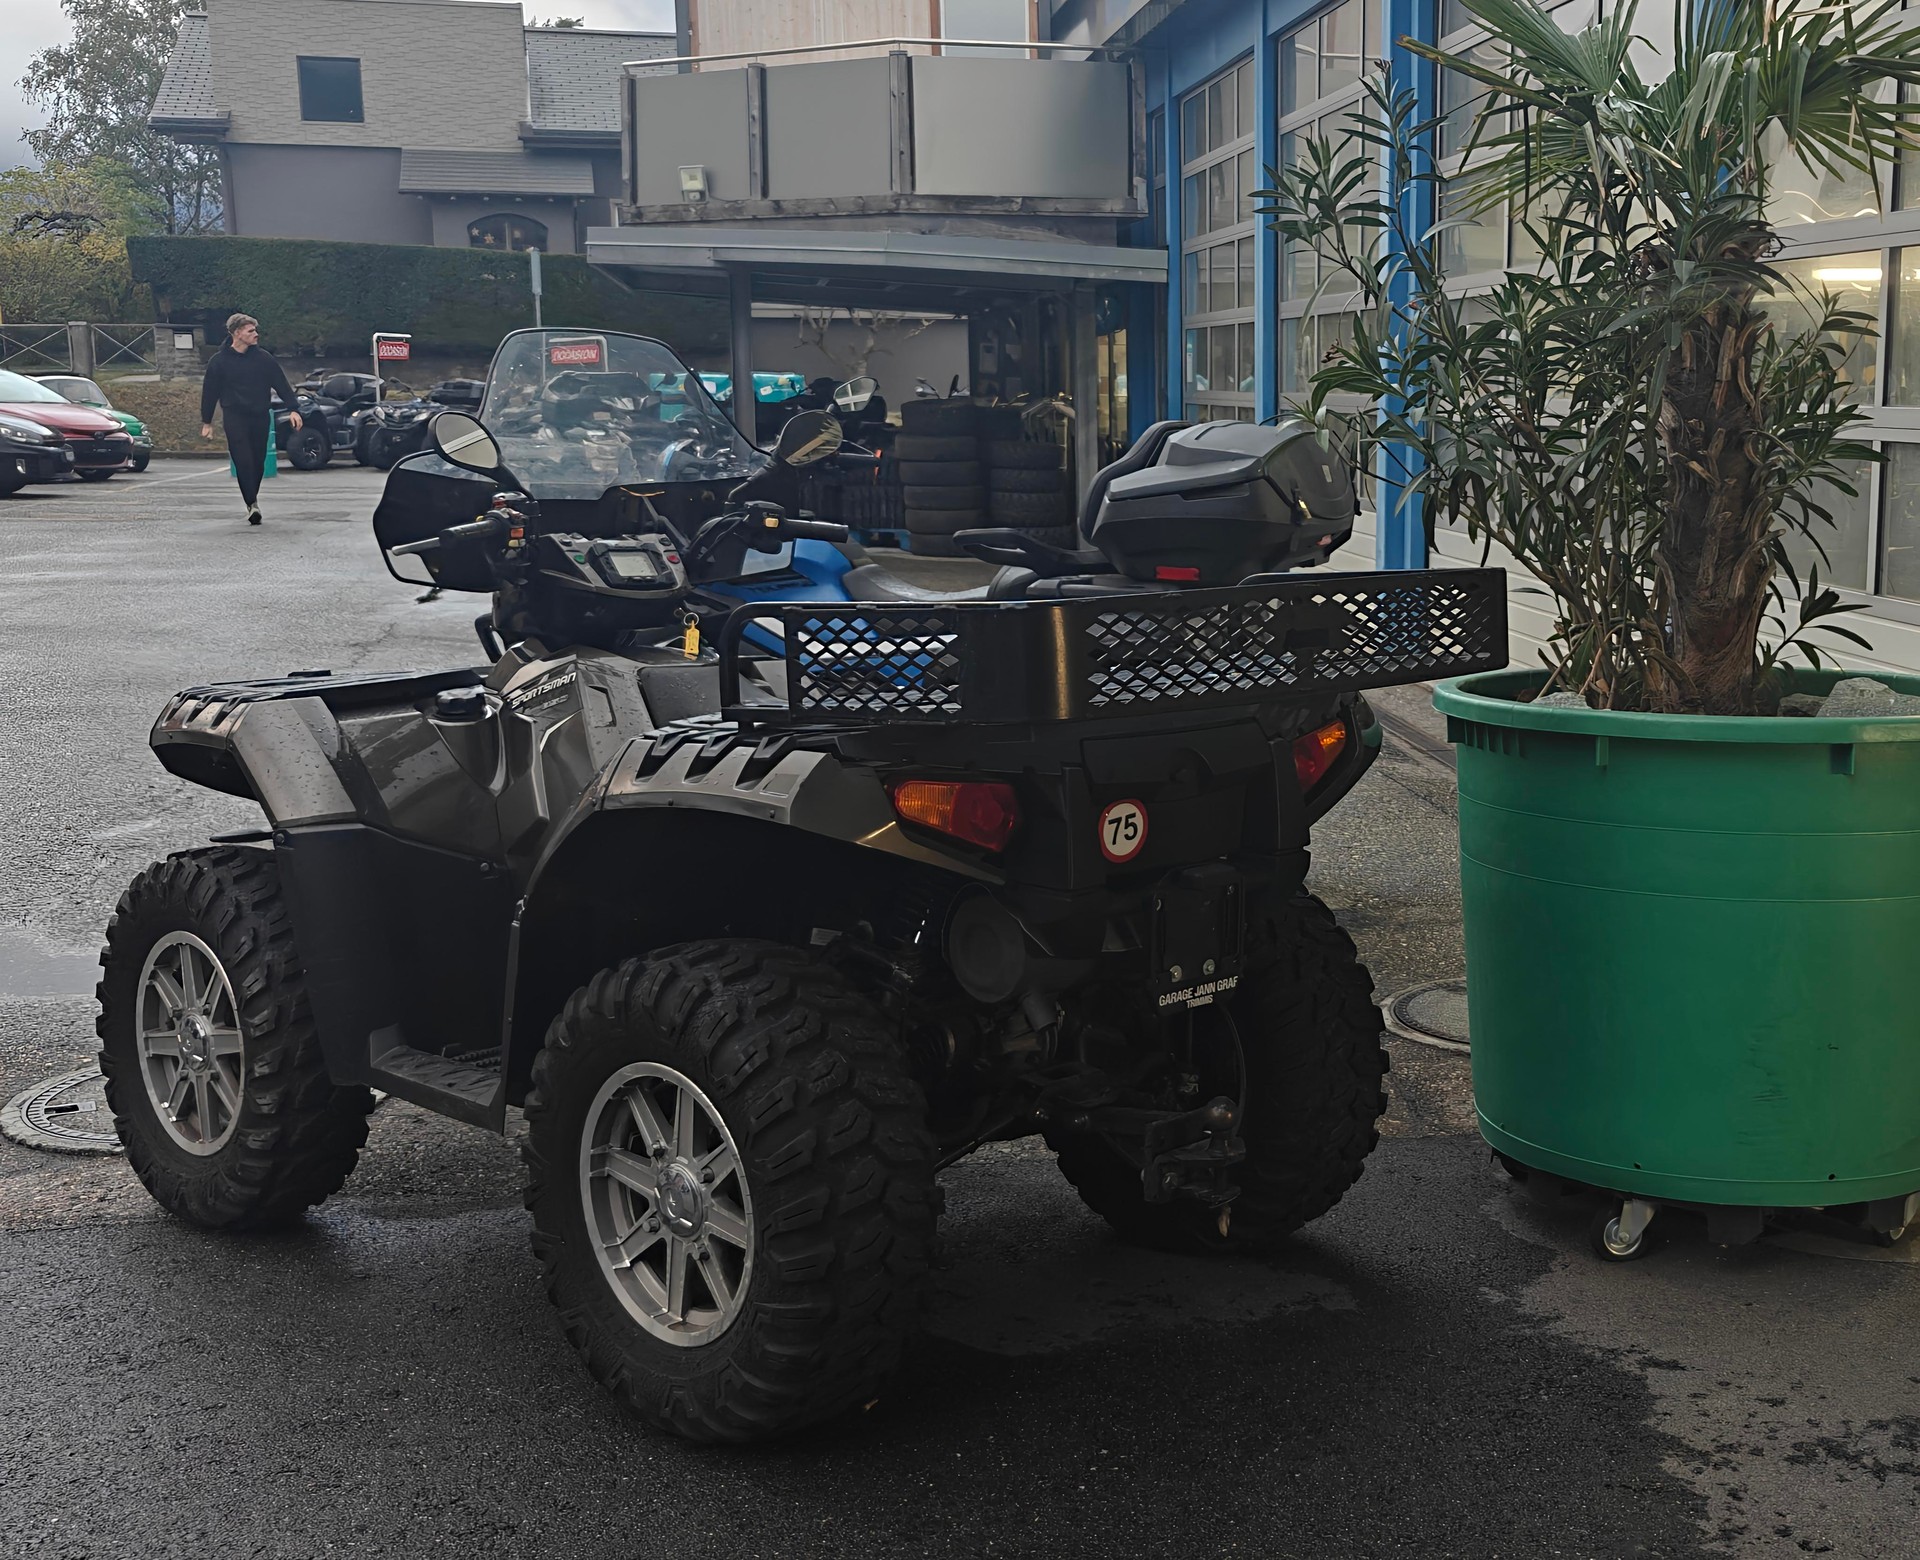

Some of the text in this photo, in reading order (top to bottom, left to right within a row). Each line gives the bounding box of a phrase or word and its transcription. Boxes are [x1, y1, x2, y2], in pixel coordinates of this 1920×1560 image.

[511, 671, 577, 709] SPORTSMAN
[1108, 812, 1138, 845] 75
[1158, 975, 1239, 1007] GARAGE JANN GRAF
[1186, 994, 1214, 1009] TRIMMIS
